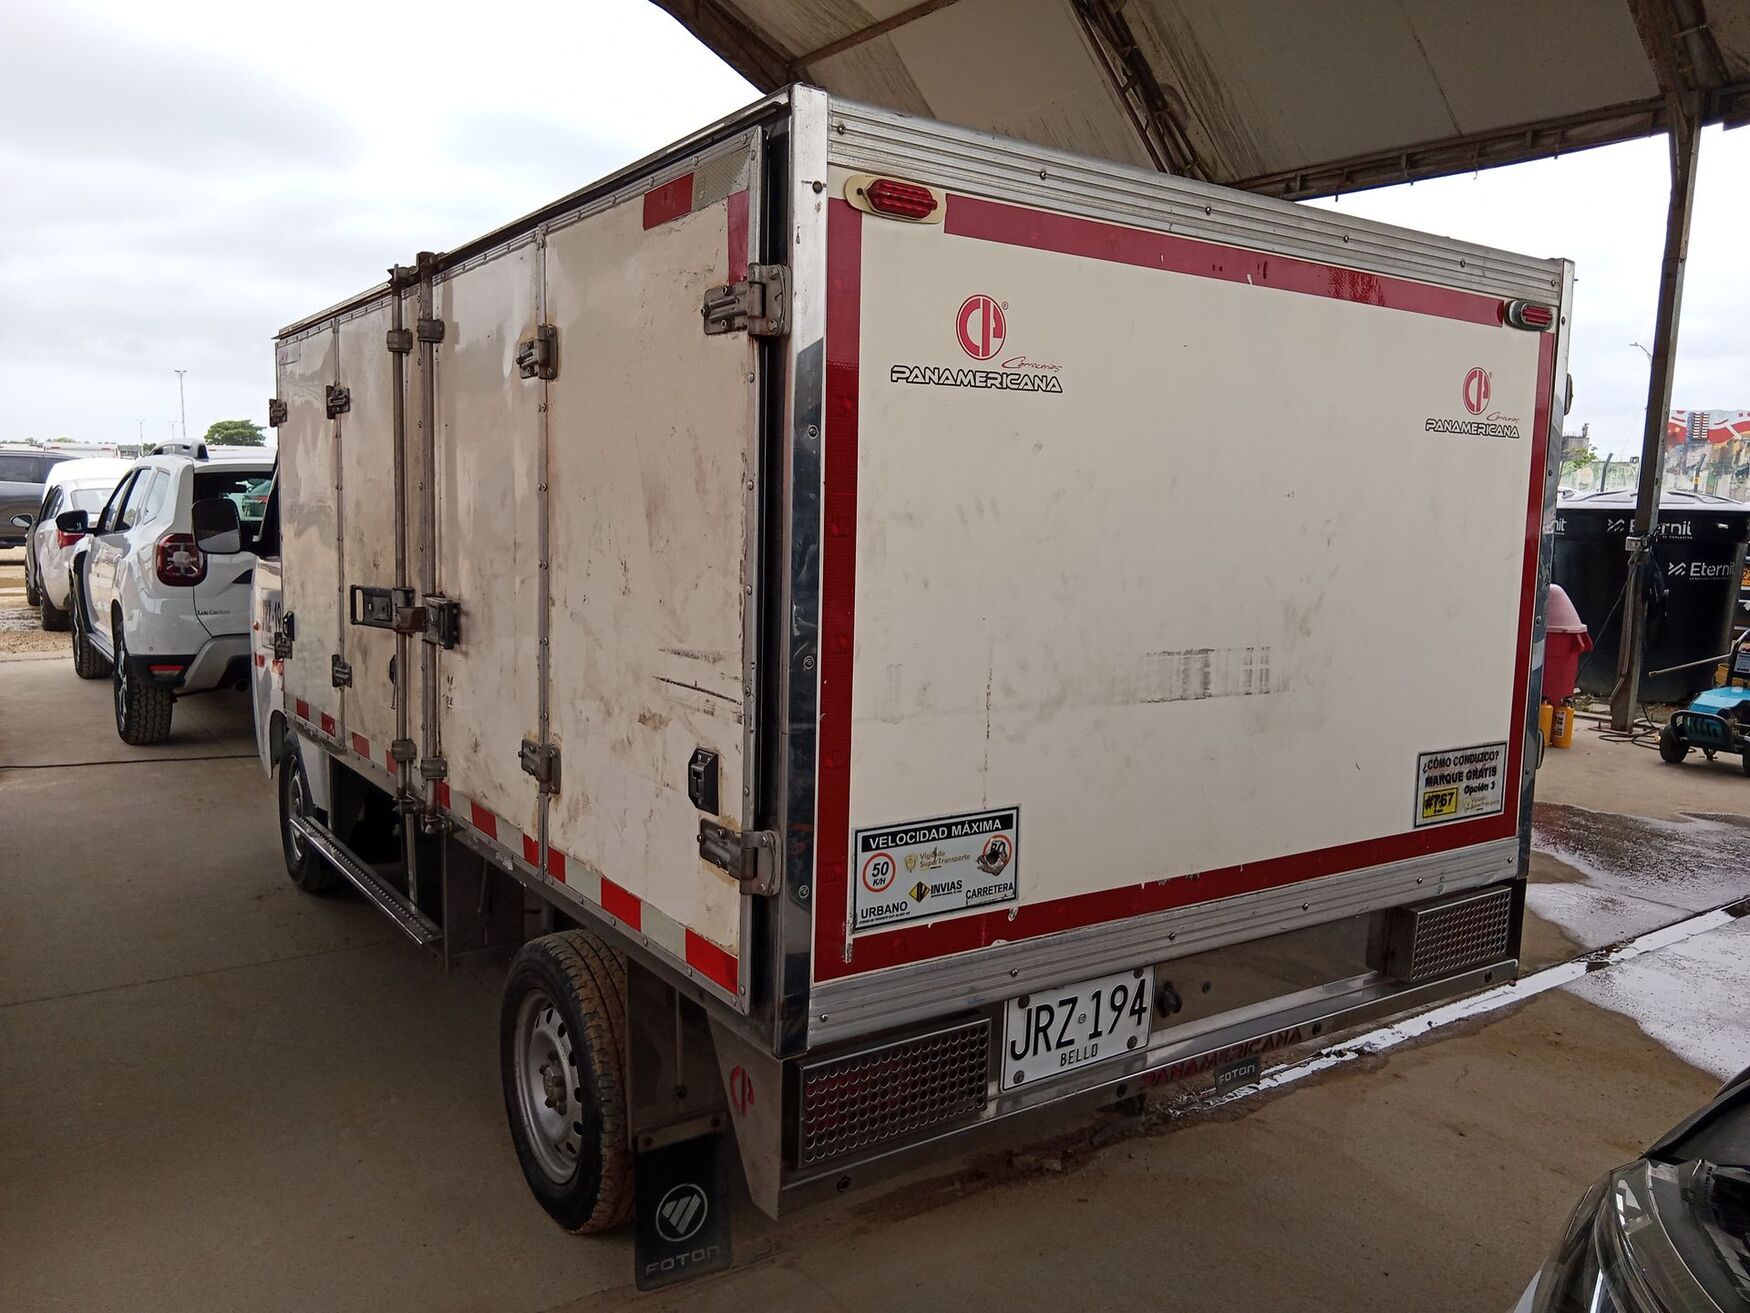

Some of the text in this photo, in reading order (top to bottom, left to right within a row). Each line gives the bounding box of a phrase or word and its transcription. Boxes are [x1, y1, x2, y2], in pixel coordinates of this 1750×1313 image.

[890, 364, 1063, 393] PANAMERICANA
[1425, 418, 1519, 438] PANAMERICANA
[1453, 750, 1499, 767] CONDUZCO?
[1425, 771, 1463, 788] MARQUE
[1424, 792, 1455, 811] #767
[869, 819, 1002, 849] VELOCIDAD MÁXIMA
[872, 861, 889, 877] 50
[872, 877, 886, 887] K/H
[931, 880, 963, 895] INVIAS
[966, 882, 1014, 900] CARRETERA
[861, 901, 908, 919] URBANO
[1010, 978, 1147, 1060] JRZ 194
[1060, 1043, 1098, 1067] BELLO
[1219, 1064, 1255, 1084] FOTON
[645, 1245, 720, 1276] FOTON
